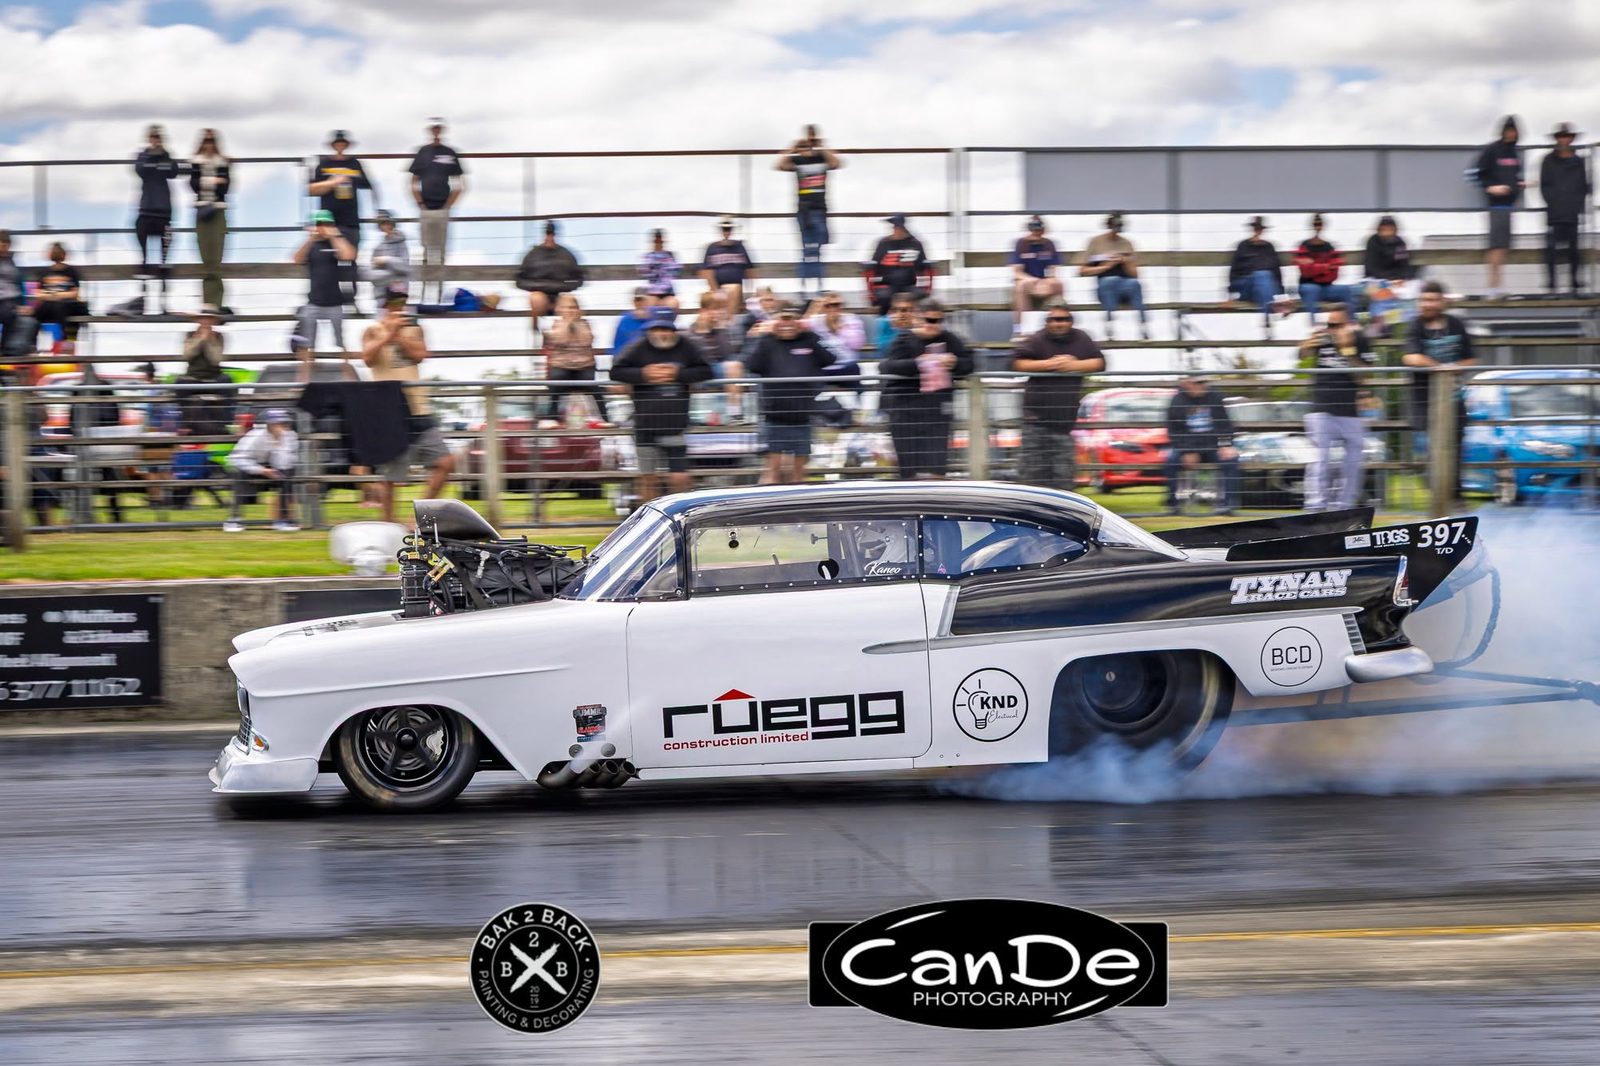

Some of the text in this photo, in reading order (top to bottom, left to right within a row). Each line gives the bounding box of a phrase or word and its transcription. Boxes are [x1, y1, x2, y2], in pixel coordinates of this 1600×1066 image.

[1417, 521, 1466, 548] 397
[1229, 569, 1352, 605] TYNAN
[1247, 586, 1348, 601] RACE CARS
[1272, 645, 1312, 666] BCD
[980, 695, 1018, 710] KND
[663, 731, 809, 751] construction limited
